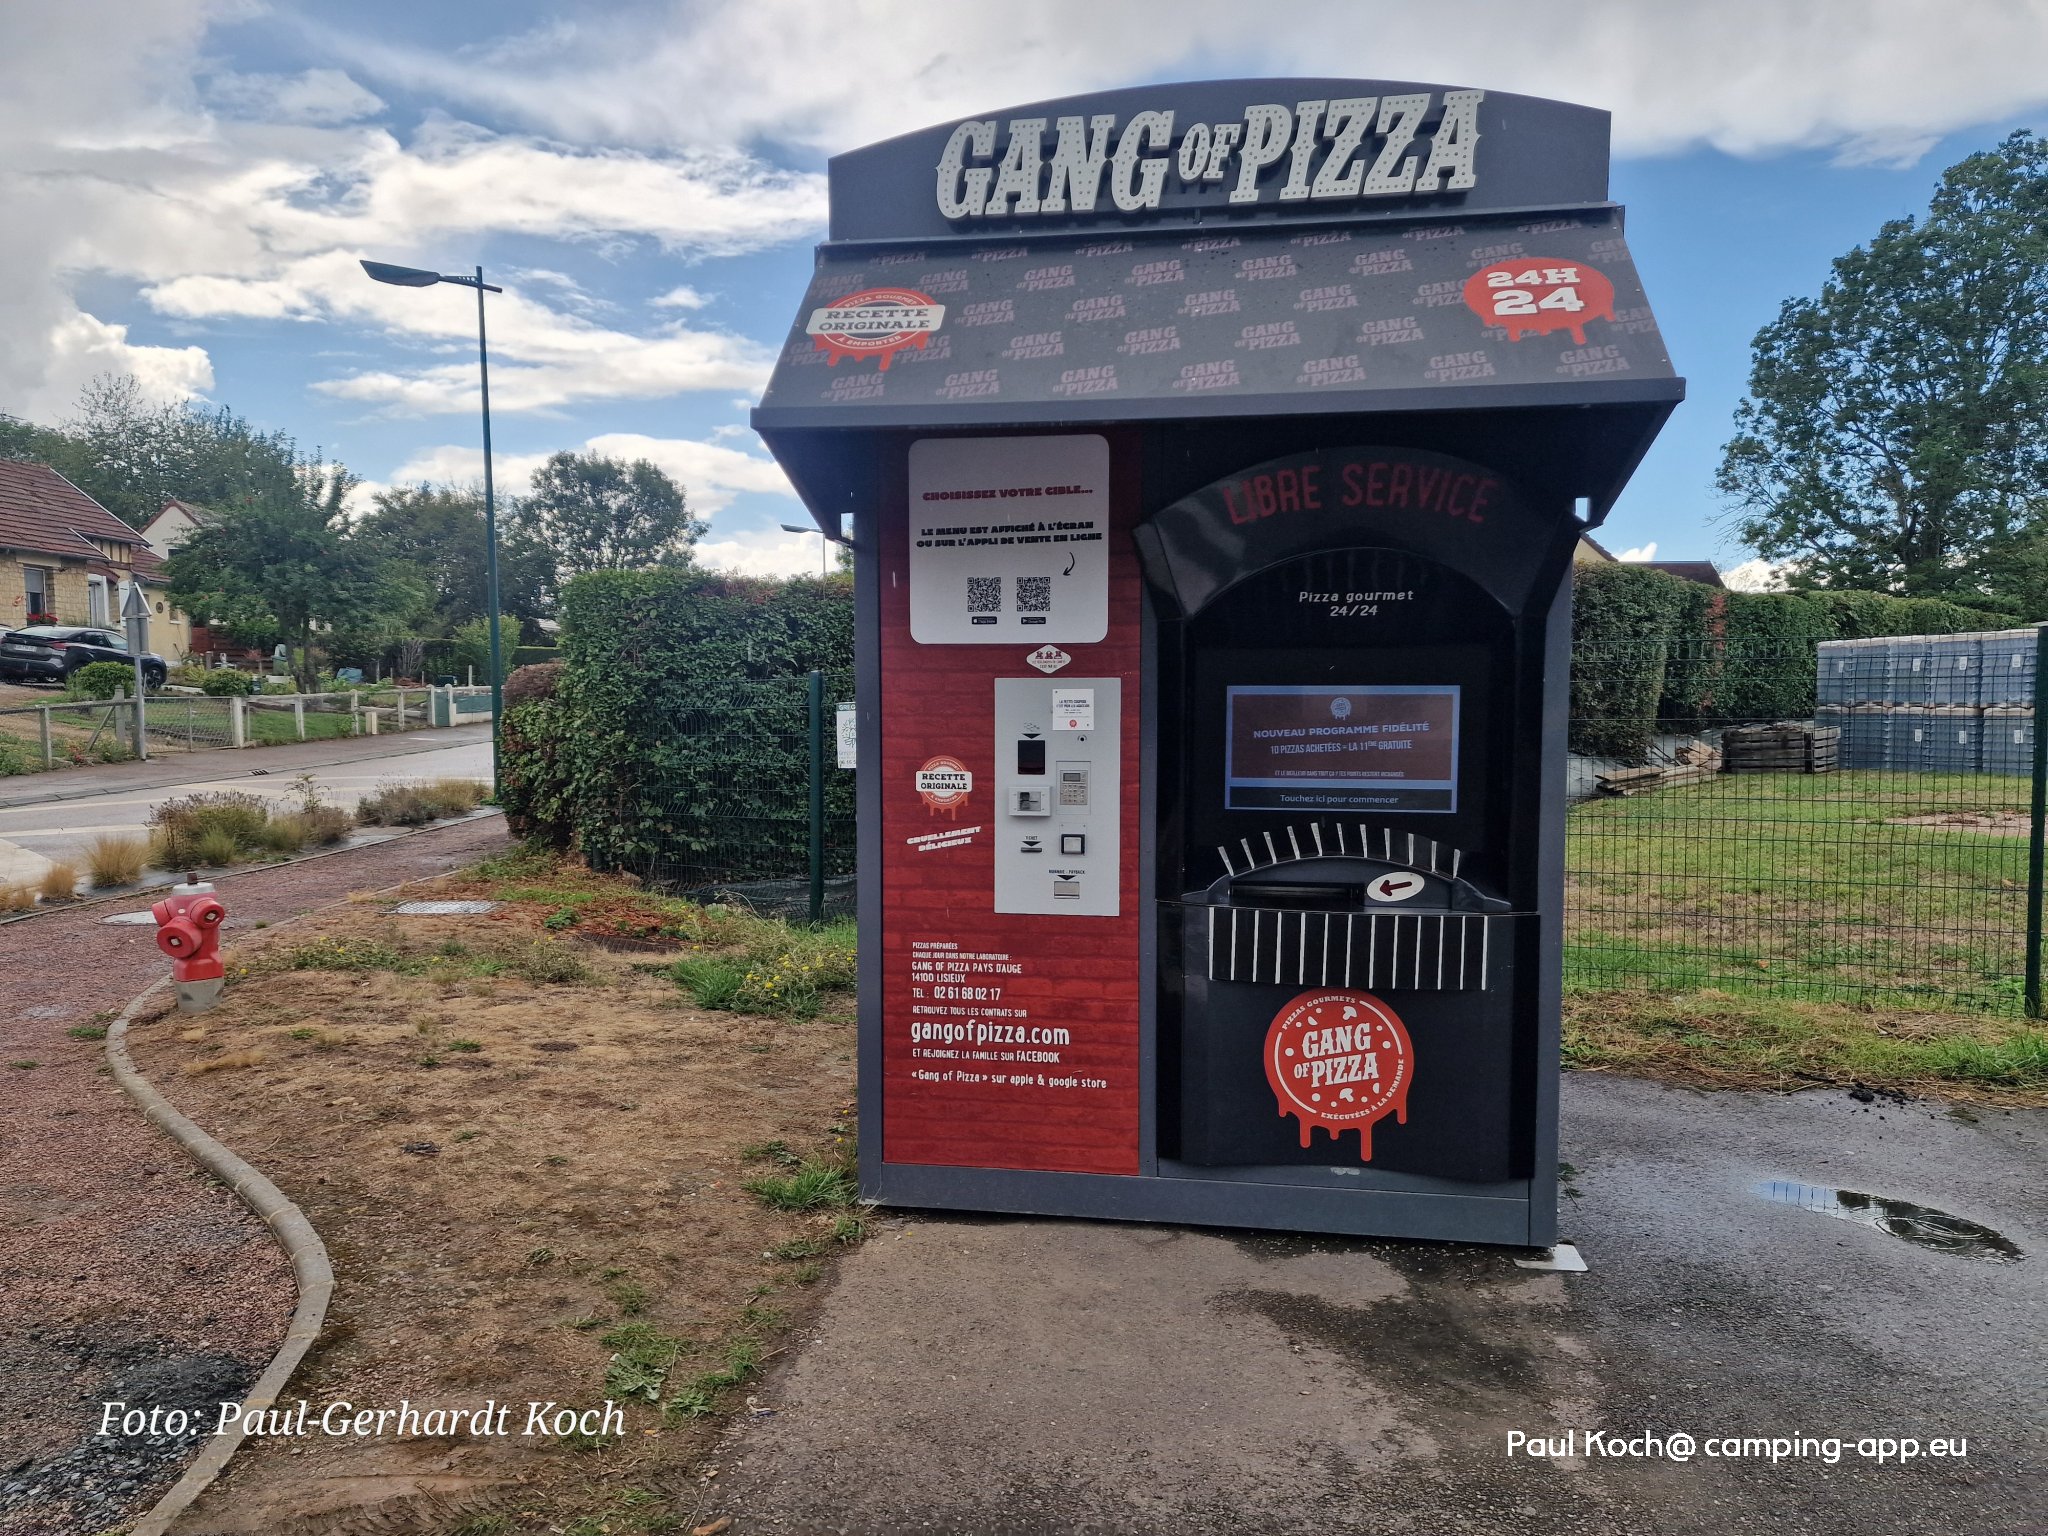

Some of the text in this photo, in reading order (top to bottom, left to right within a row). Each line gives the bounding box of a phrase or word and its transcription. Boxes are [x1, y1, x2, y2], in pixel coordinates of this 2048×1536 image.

[936, 90, 1485, 219] GANG OF PIZZA
[1131, 259, 1181, 276] GANG
[1242, 255, 1292, 271] GANG
[1135, 270, 1185, 287] PIZZA
[1247, 265, 1297, 281] PIZZA
[1486, 267, 1581, 287] 24H
[1184, 289, 1236, 306] GANG
[1300, 284, 1351, 301] GANG
[1492, 286, 1585, 316] 24
[1190, 300, 1241, 317] PIZZA
[1307, 295, 1359, 313] PIZZA
[825, 308, 929, 320] RECETTE
[818, 320, 931, 332] ORIGINALE
[1362, 316, 1417, 334] GANG
[1124, 326, 1177, 344] GANG
[1370, 327, 1424, 346] PIZZA
[1128, 337, 1181, 355] PIZZA
[1559, 345, 1619, 364] GANG
[1303, 354, 1359, 374] GANG
[1571, 357, 1631, 377] PIZZA
[831, 372, 885, 390] GANG
[1061, 365, 1115, 383] GANG
[1310, 367, 1366, 386] PIZZA
[832, 384, 885, 401] PIZZA
[1064, 377, 1118, 396] PIZZA
[922, 489, 997, 501] CHOISISSEZ
[999, 487, 1042, 499] VOTRE
[1222, 462, 1498, 525] LIBRE SERVICE
[921, 528, 934, 536] LE
[935, 527, 967, 535] MENU
[969, 526, 988, 534] EST
[991, 522, 1035, 533] AFFICHÉ
[934, 539, 956, 547] SUR
[1017, 535, 1051, 544] VENTE
[1053, 534, 1068, 542] EN
[1070, 532, 1102, 541] LIGNE
[1299, 590, 1414, 604] Pizza gourmet
[1330, 604, 1379, 617] 24/24
[1253, 721, 1431, 739] NOUVEAU PROGRAMME FIDÉLITÉ
[1270, 745, 1279, 755] 10
[1280, 743, 1305, 754] PIZZAS
[1305, 741, 1341, 753] ACHETÉES
[1348, 742, 1358, 751] LA
[1378, 739, 1412, 750] GRATUITE
[922, 773, 966, 781] RECETTE
[920, 782, 968, 790] ORIGINALE
[1280, 794, 1315, 802] Touchez
[1327, 796, 1347, 804] pour
[1349, 796, 1399, 804] commencer
[907, 826, 981, 844] CRUELLEMENT
[918, 837, 972, 851] DÉLICIEUX
[911, 961, 933, 971] GANG
[935, 962, 945, 971] OF
[947, 962, 970, 972] PIZZA
[972, 963, 993, 973] PAYS
[911, 972, 966, 983] 14100 LISIEUX
[912, 988, 925, 998] TEL
[934, 986, 946, 999] 02
[947, 986, 959, 999] 61
[961, 987, 973, 1000] 68
[975, 987, 987, 1000] 02
[989, 987, 1001, 1001] 17
[912, 1005, 1027, 1018] RETROUVEZ TOUS LES CONTRATS SUR
[1281, 995, 1356, 1031] PIZZAS GOURMETS
[910, 1019, 1070, 1046] gangofpizza.com
[1301, 1022, 1371, 1059] GANG
[912, 1048, 1060, 1063] ET REJOIGNEZ LA FAMILLE SUR FACEBOOK
[1293, 1052, 1379, 1088] OF PIZZA
[942, 1070, 953, 1081] of
[956, 1070, 980, 1082] Pizza
[991, 1075, 1006, 1083] sur
[1010, 1074, 1034, 1086] apple
[1037, 1074, 1045, 1086] &
[1048, 1076, 1078, 1088] google
[1081, 1077, 1107, 1088] store
[1320, 1108, 1371, 1120] EXÉCUTÉES
[1377, 1097, 1388, 1107] LA
[1387, 1058, 1405, 1098] DEMANDE
